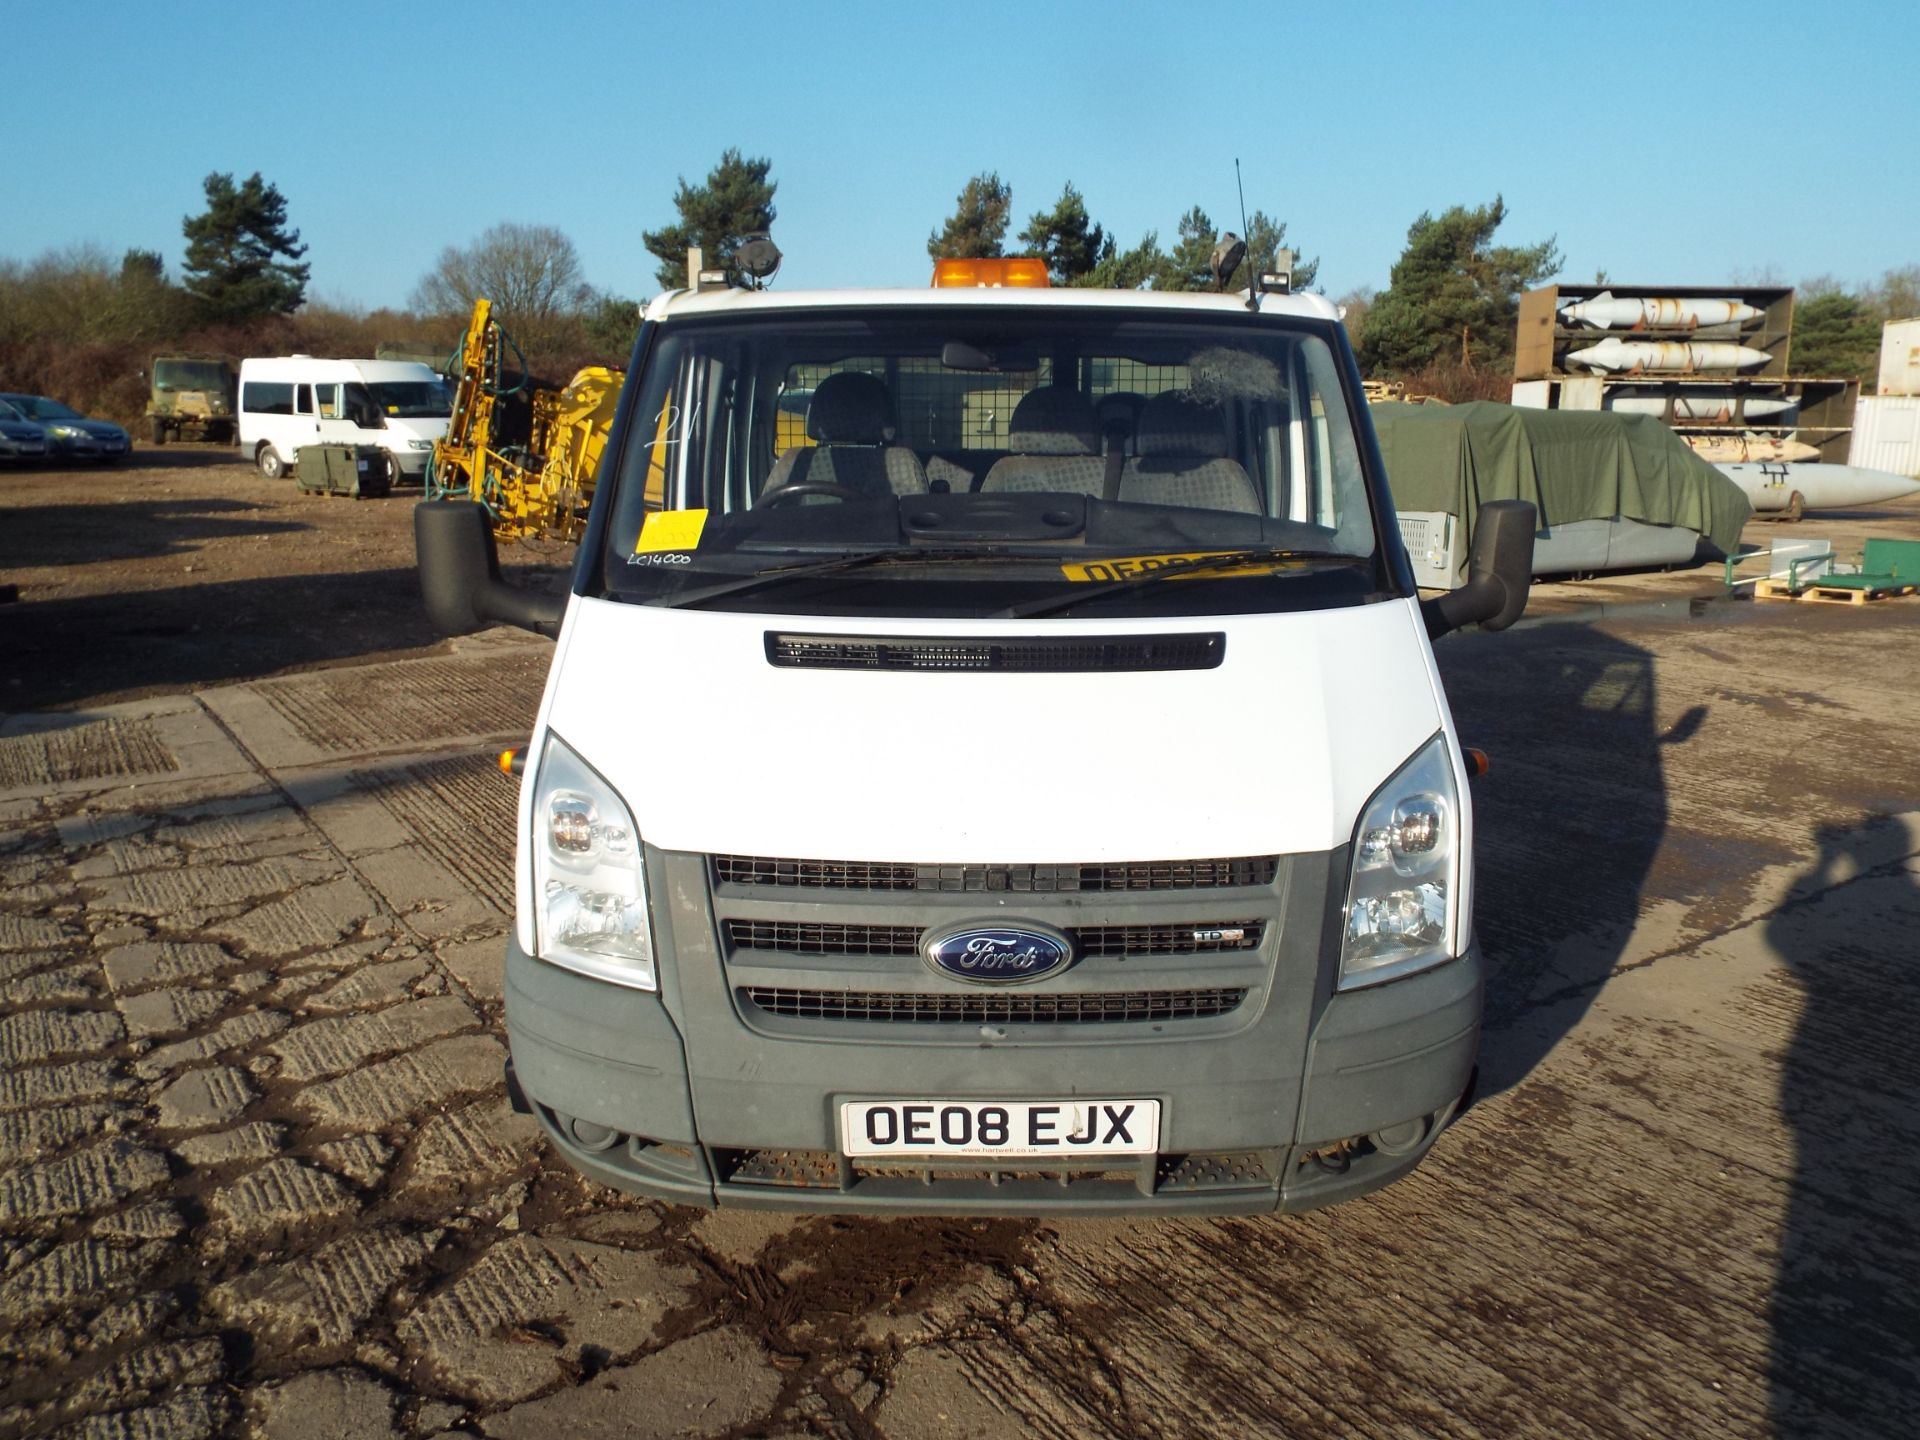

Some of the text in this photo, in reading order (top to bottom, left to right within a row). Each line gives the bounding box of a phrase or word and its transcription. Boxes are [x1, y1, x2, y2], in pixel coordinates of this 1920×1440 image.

[627, 553, 691, 566] LC14000
[960, 937, 1038, 969] Ford
[865, 1105, 1135, 1145] OE08 EJX
